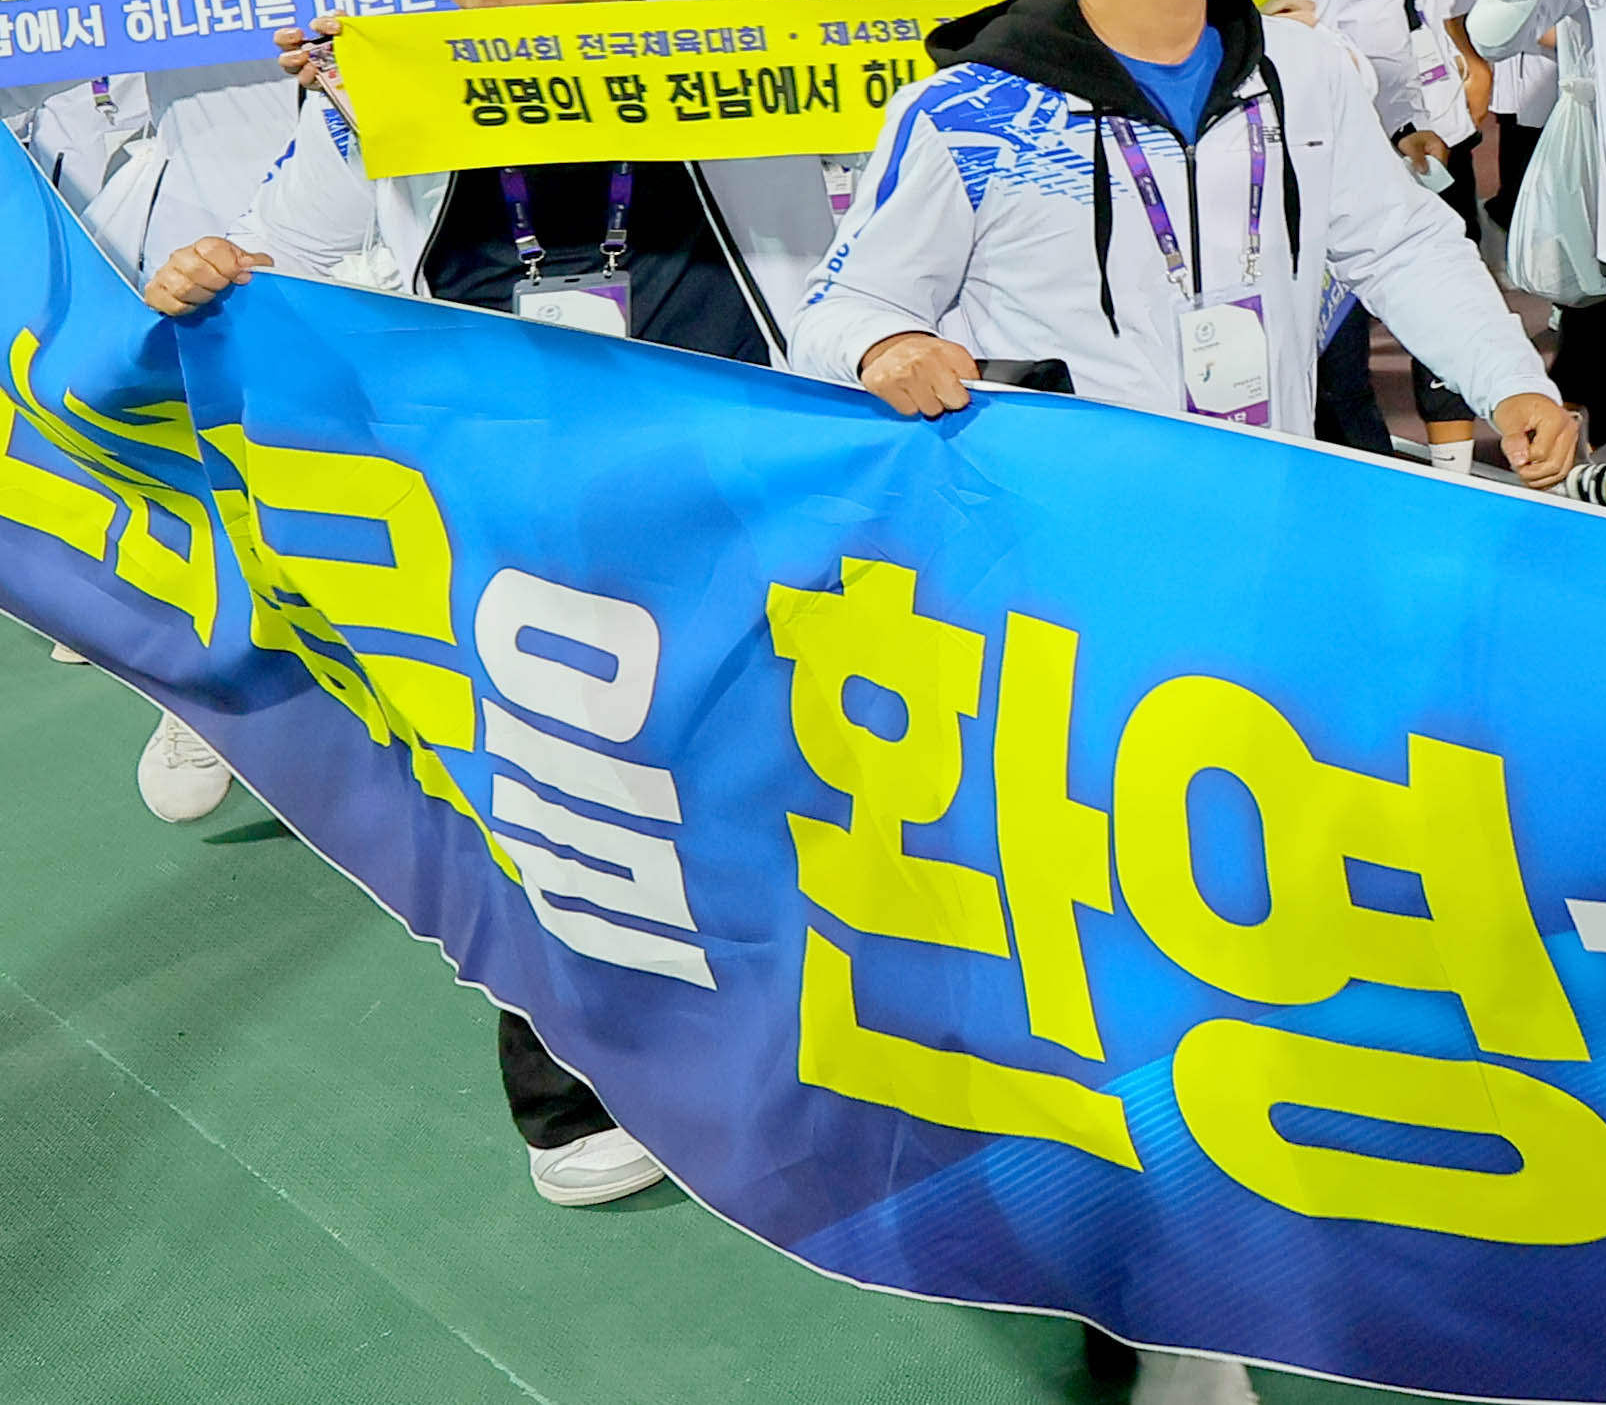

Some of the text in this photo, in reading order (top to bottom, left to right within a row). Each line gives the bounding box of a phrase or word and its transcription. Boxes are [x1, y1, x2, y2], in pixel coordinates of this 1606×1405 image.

[445, 18, 923, 64] 제104회 전국체육대회 제43회
[463, 74, 595, 127] 생명의
[602, 72, 649, 124] 땅
[667, 62, 842, 122] 전남에서
